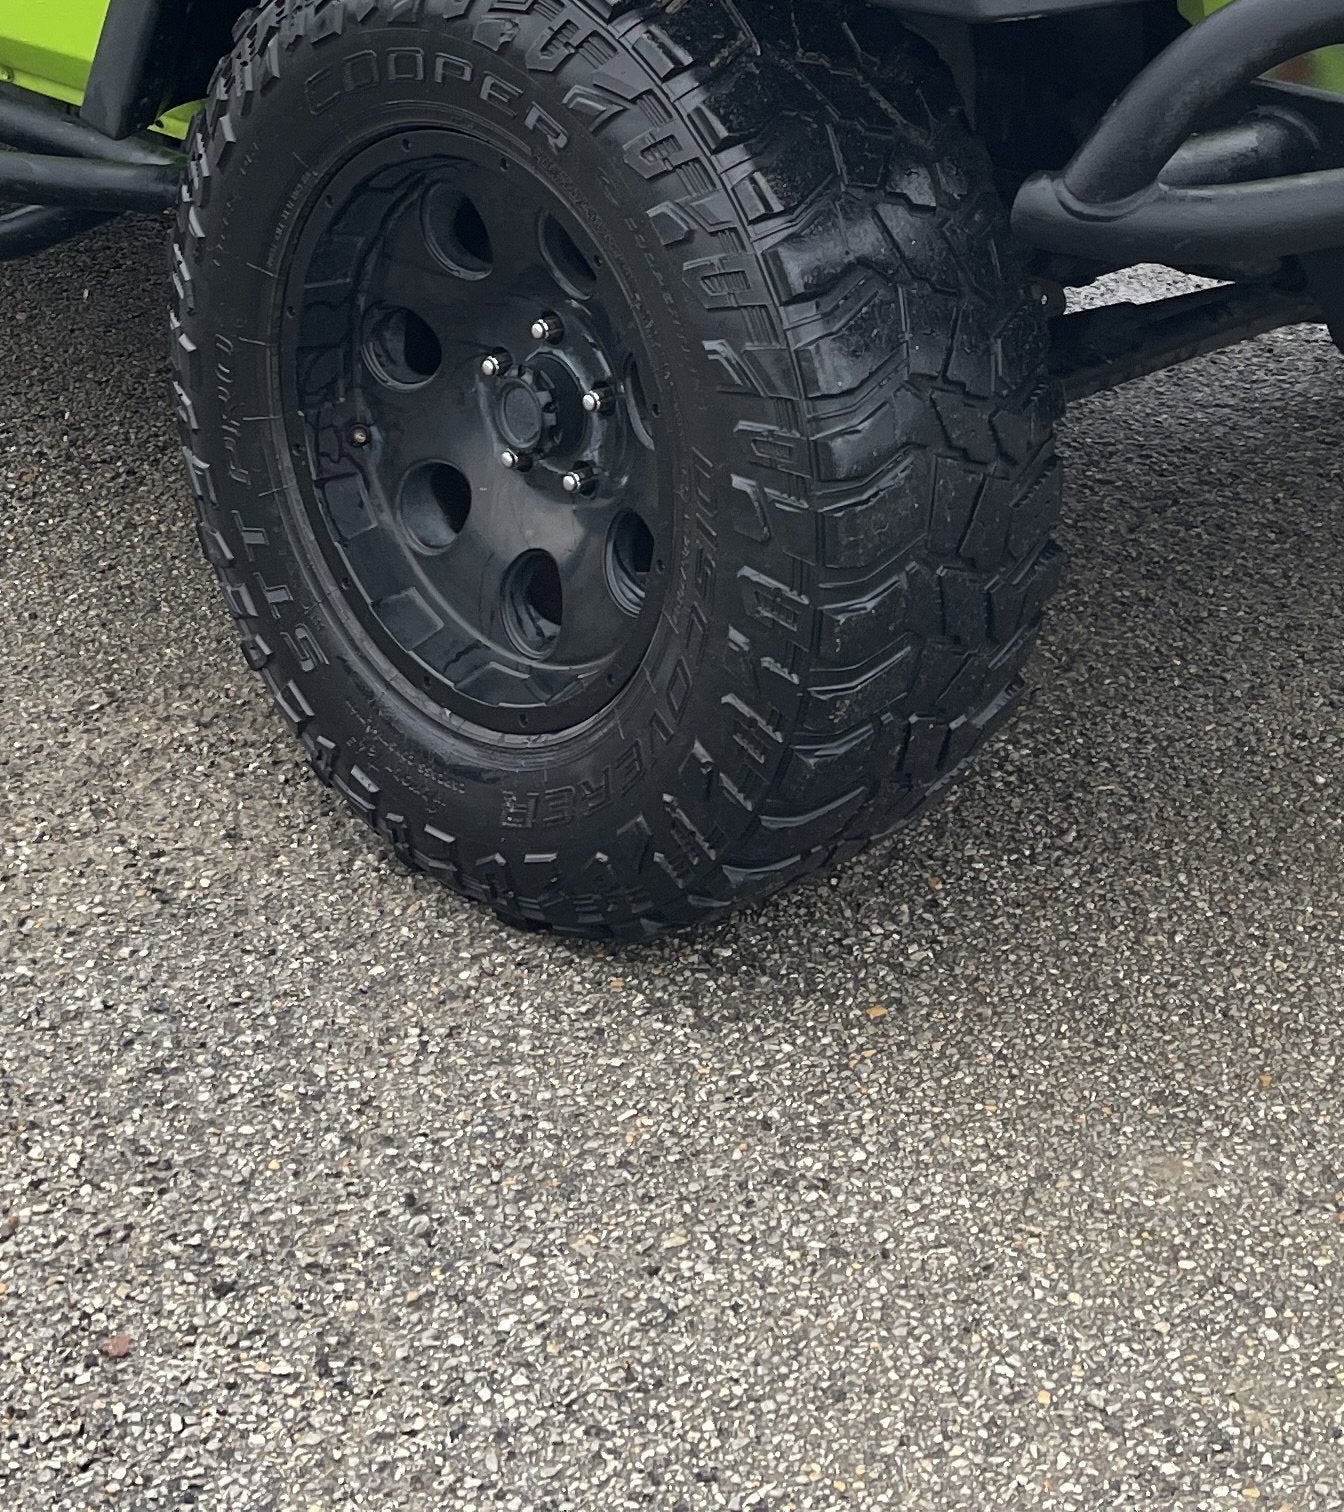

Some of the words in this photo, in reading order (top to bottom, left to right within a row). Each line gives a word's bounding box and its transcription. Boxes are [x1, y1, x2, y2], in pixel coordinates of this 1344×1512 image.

[302, 45, 570, 153] COOPER
[231, 508, 331, 673] STT
[499, 445, 719, 831] DISCOVERER
